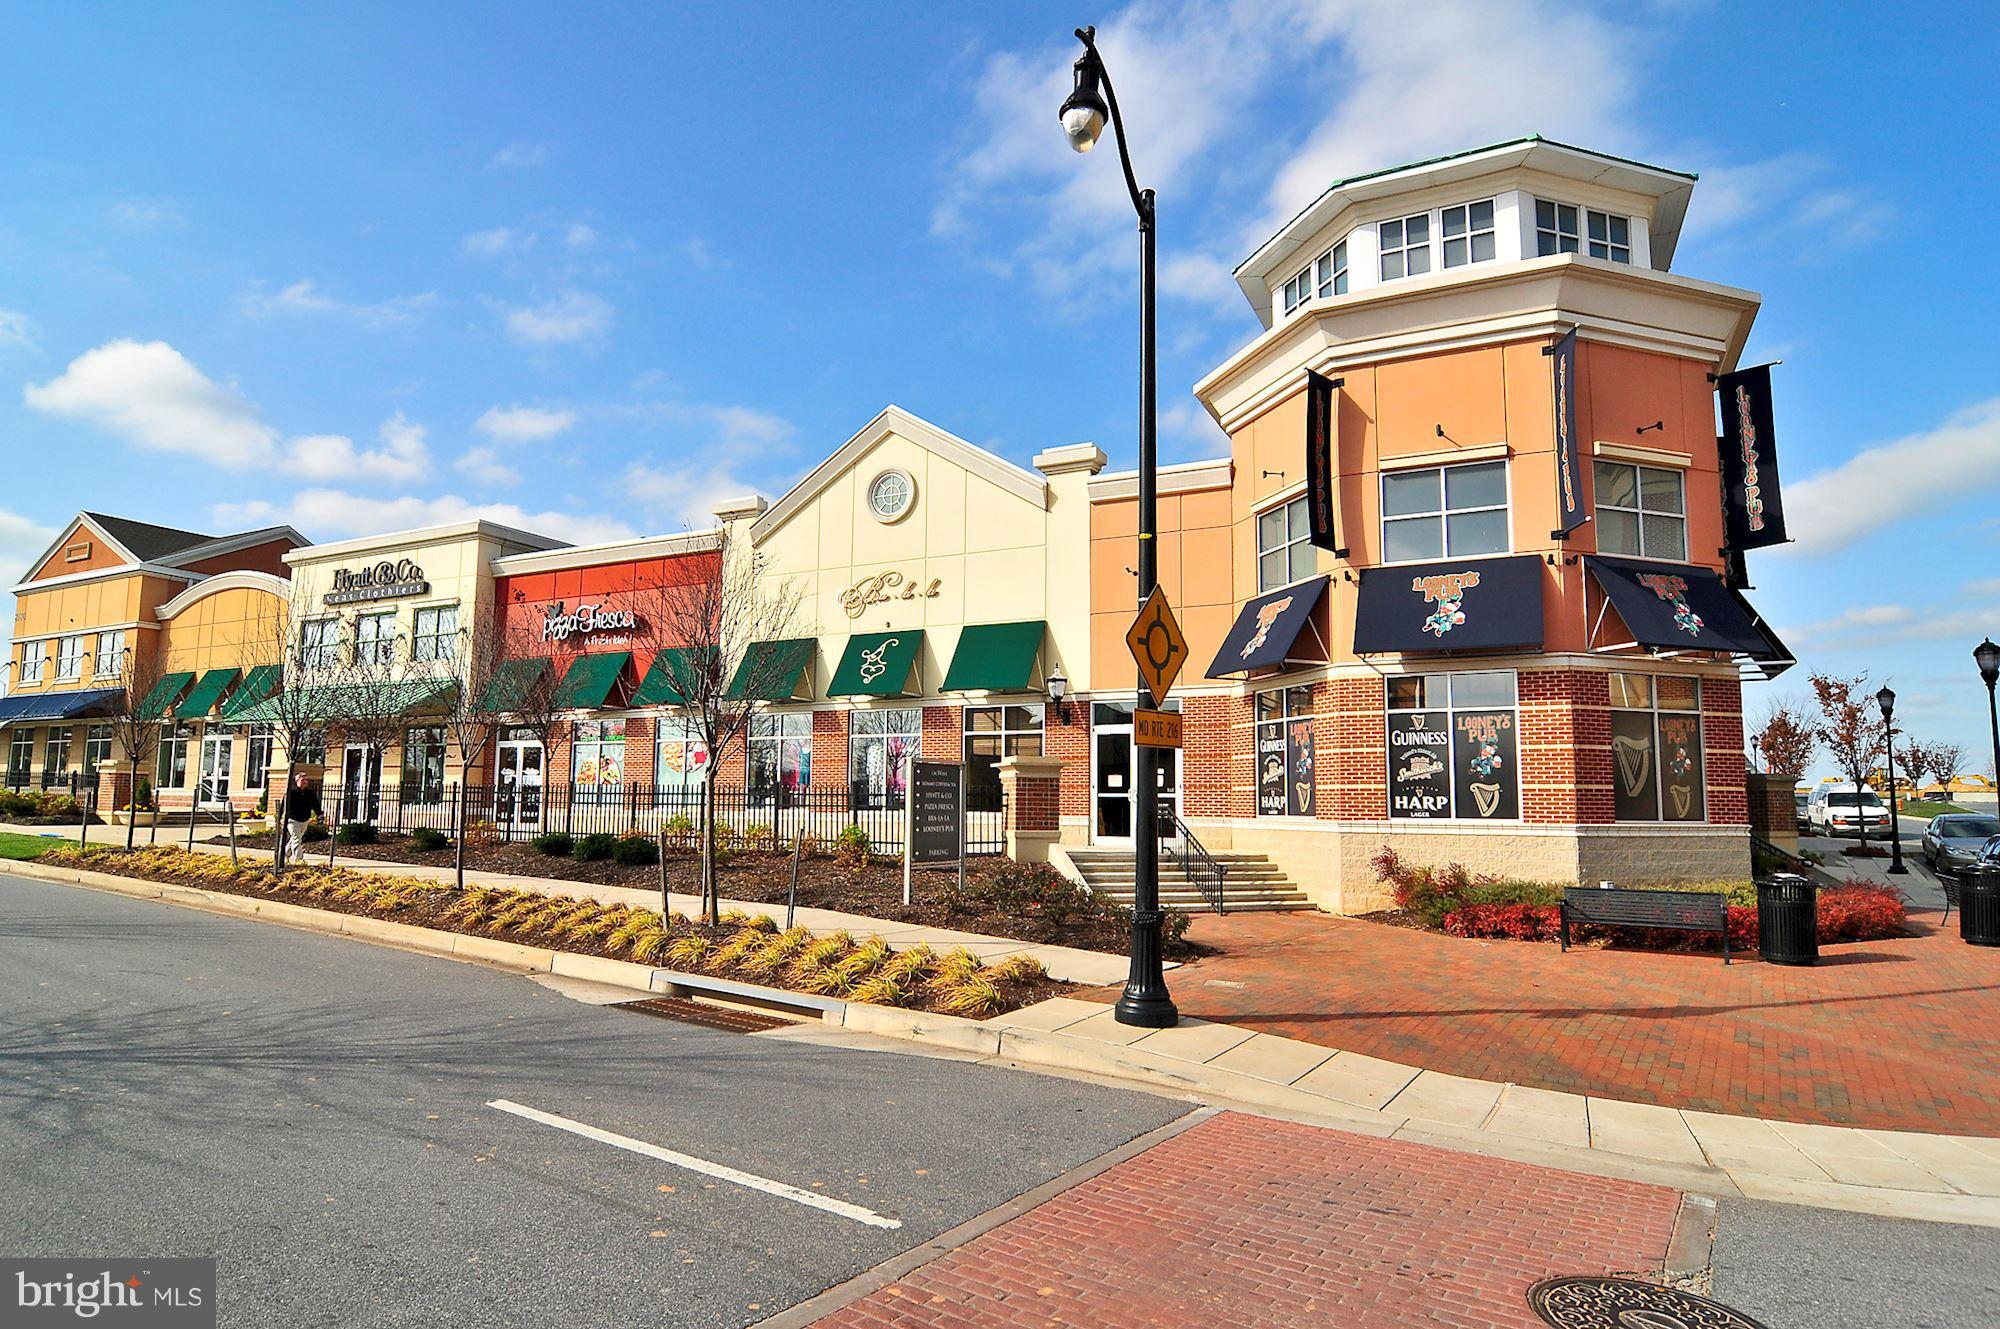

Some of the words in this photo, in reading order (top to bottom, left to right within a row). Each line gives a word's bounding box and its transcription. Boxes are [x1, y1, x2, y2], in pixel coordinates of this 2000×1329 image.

[332, 566, 371, 592] Hyatt
[359, 584, 421, 599] Clothiers
[1138, 719, 1149, 736] MD
[1151, 720, 1163, 737] RTE
[1167, 721, 1179, 739] 216
[1468, 728, 1498, 743] PUB
[1391, 730, 1448, 746] GUINNESS
[1261, 795, 1286, 809] HARP
[1395, 795, 1449, 811] HARP
